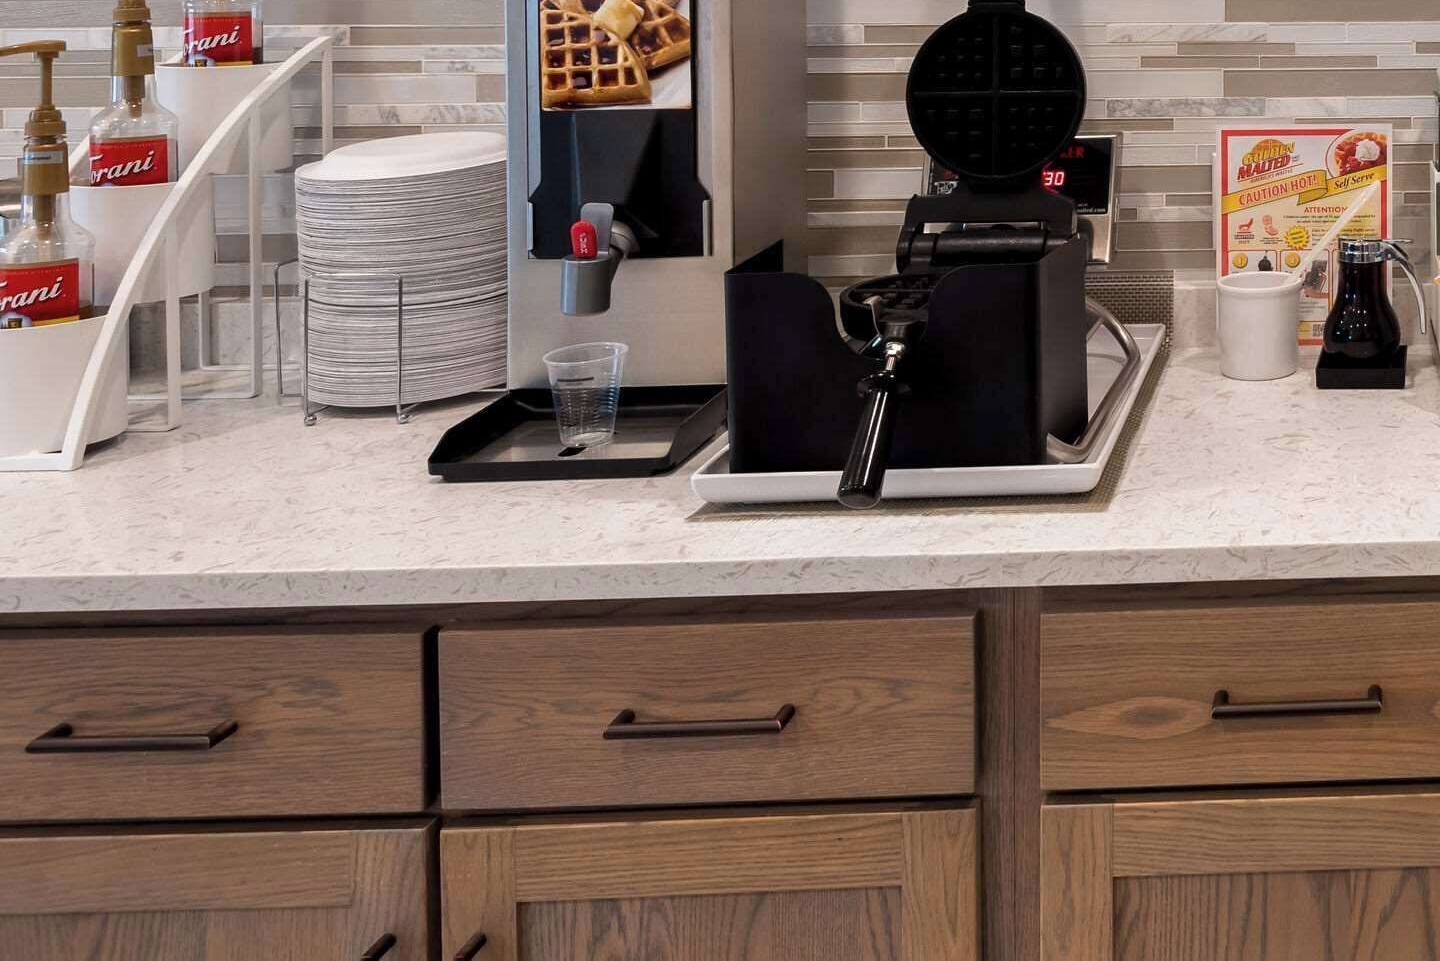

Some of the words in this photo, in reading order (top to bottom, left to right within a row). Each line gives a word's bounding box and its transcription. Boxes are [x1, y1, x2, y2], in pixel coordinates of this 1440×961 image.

[1241, 141, 1296, 166] GOLDEN
[89, 150, 155, 184] Torani
[1236, 154, 1292, 180] MALTED
[1238, 183, 1289, 206] CAUTION
[1290, 174, 1318, 191] HOT!
[1333, 177, 1351, 190] Self
[1350, 171, 1375, 185] Serve
